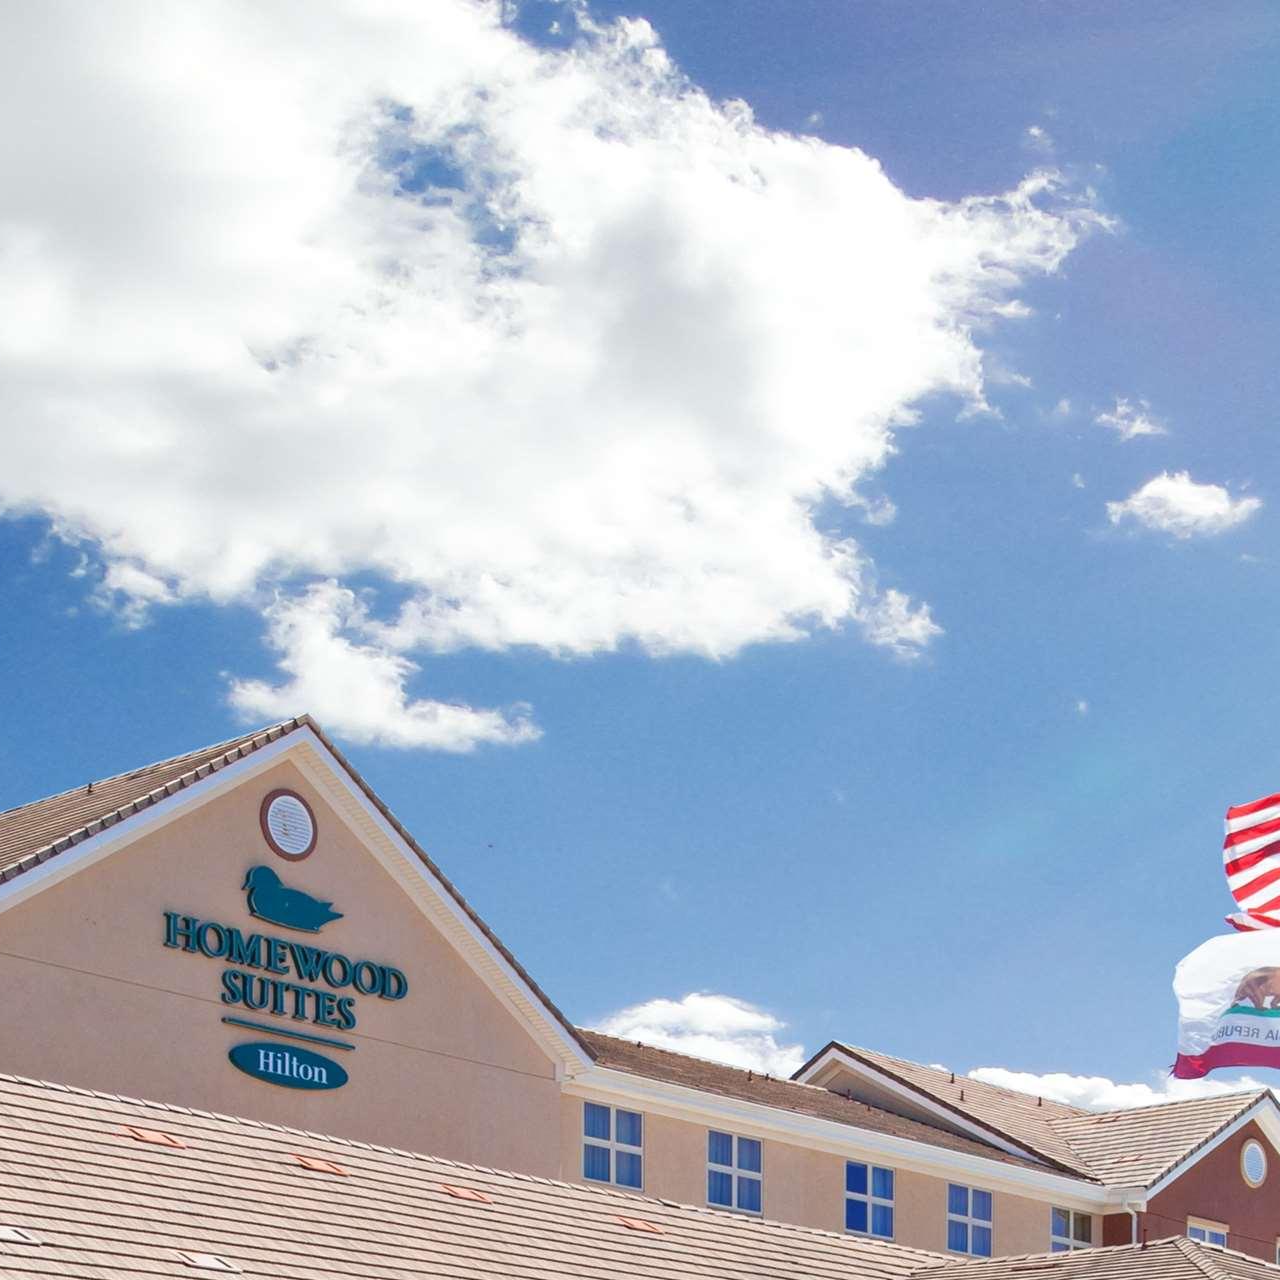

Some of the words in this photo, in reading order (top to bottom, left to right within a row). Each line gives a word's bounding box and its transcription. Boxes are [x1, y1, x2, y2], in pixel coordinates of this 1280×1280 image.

[163, 911, 409, 1000] HOMEWOOD
[221, 968, 357, 1030] SUITES
[257, 1049, 329, 1085] Hilton
